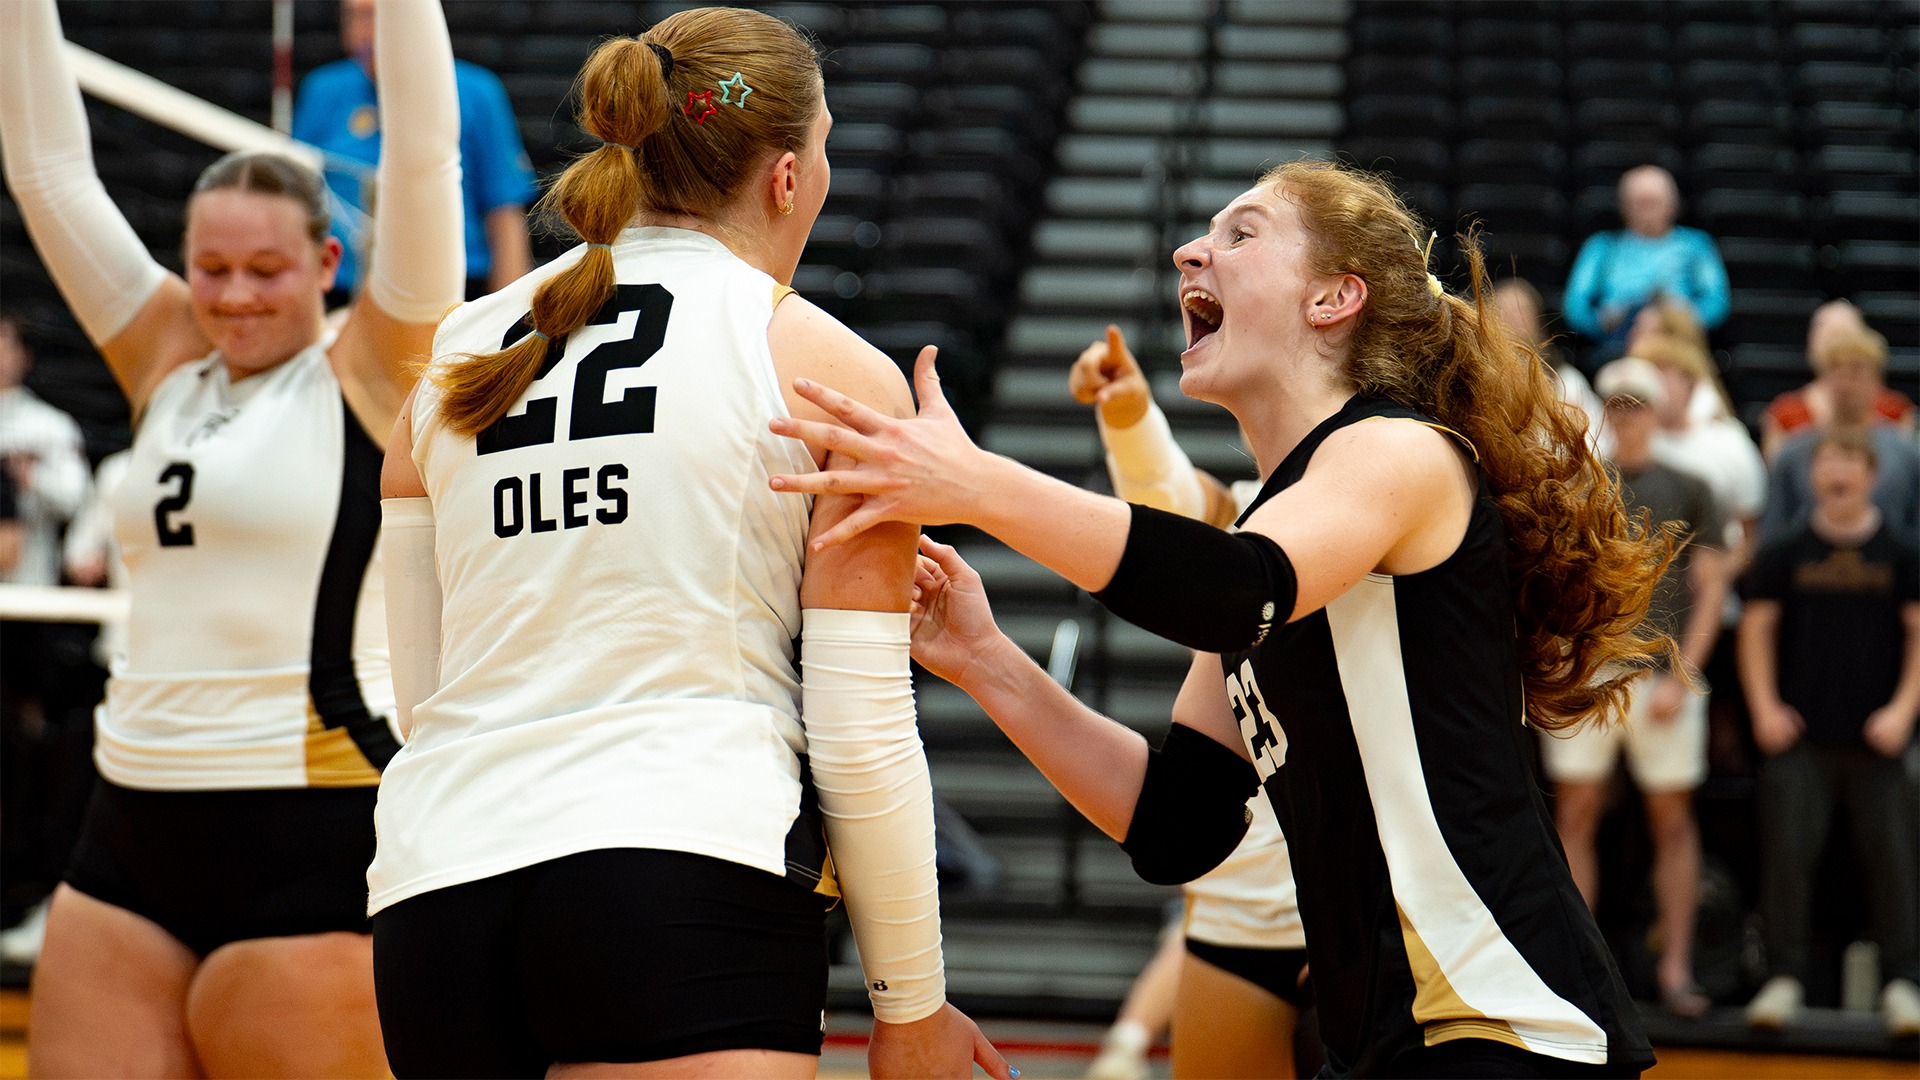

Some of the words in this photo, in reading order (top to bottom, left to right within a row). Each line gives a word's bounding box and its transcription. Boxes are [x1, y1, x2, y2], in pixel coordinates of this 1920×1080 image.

[476, 283, 674, 456] 22
[154, 461, 195, 547] 2
[493, 463, 629, 539] OLES
[1226, 658, 1289, 785] 23
